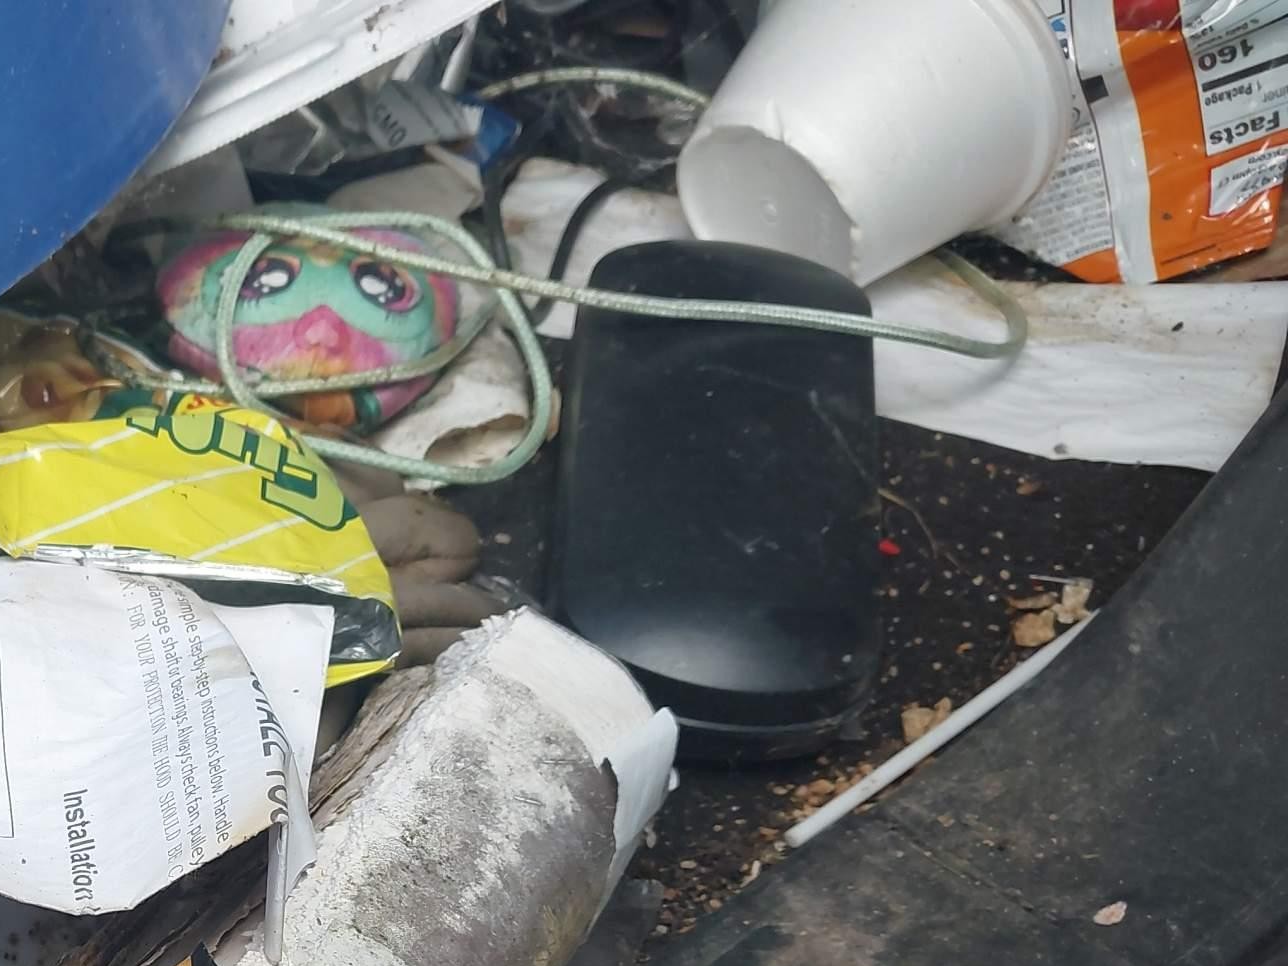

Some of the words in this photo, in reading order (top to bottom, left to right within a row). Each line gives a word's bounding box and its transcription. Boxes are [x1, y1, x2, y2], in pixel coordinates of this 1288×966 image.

[1196, 39, 1255, 72] 160
[1203, 82, 1252, 107] Package
[1207, 110, 1282, 145] Facts
[126, 604, 146, 629] FOR
[146, 583, 173, 634] damage
[132, 633, 155, 665] YOUR
[161, 636, 184, 665] shaft
[188, 634, 210, 698] step-by-step
[167, 668, 180, 678] or
[141, 670, 166, 734] PROTECTION
[169, 676, 189, 725] bearings.
[151, 735, 168, 756] THE
[172, 726, 196, 763] Always
[201, 697, 220, 760] instructions
[153, 756, 172, 788] HOOD
[180, 762, 200, 797] check
[208, 758, 227, 798] below.
[158, 791, 181, 841] SHOULD
[185, 795, 201, 826] fan,
[212, 795, 232, 843] Handle
[63, 788, 99, 901] Installation
[166, 846, 182, 864] BE
[186, 826, 207, 866] pulley
